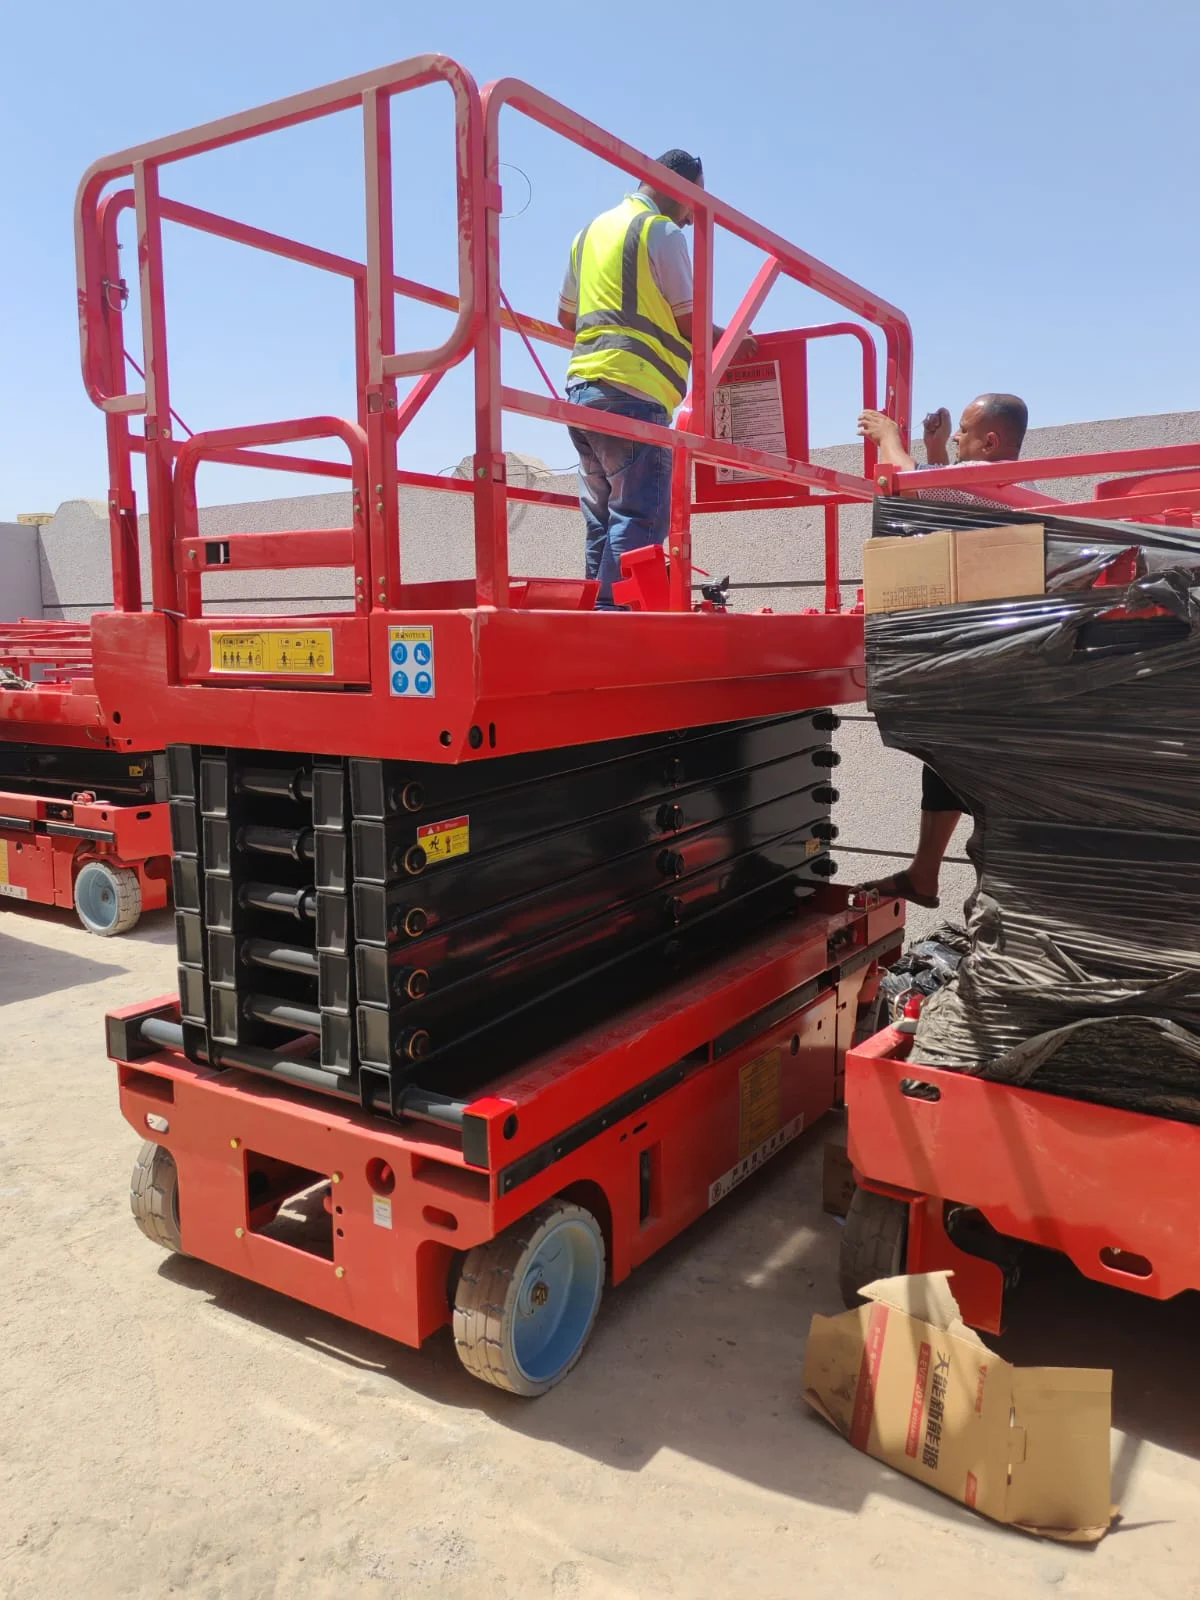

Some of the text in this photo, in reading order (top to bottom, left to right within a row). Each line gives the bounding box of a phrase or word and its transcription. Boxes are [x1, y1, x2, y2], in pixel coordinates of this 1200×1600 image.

[922, 1351, 951, 1470] 天能新能源
